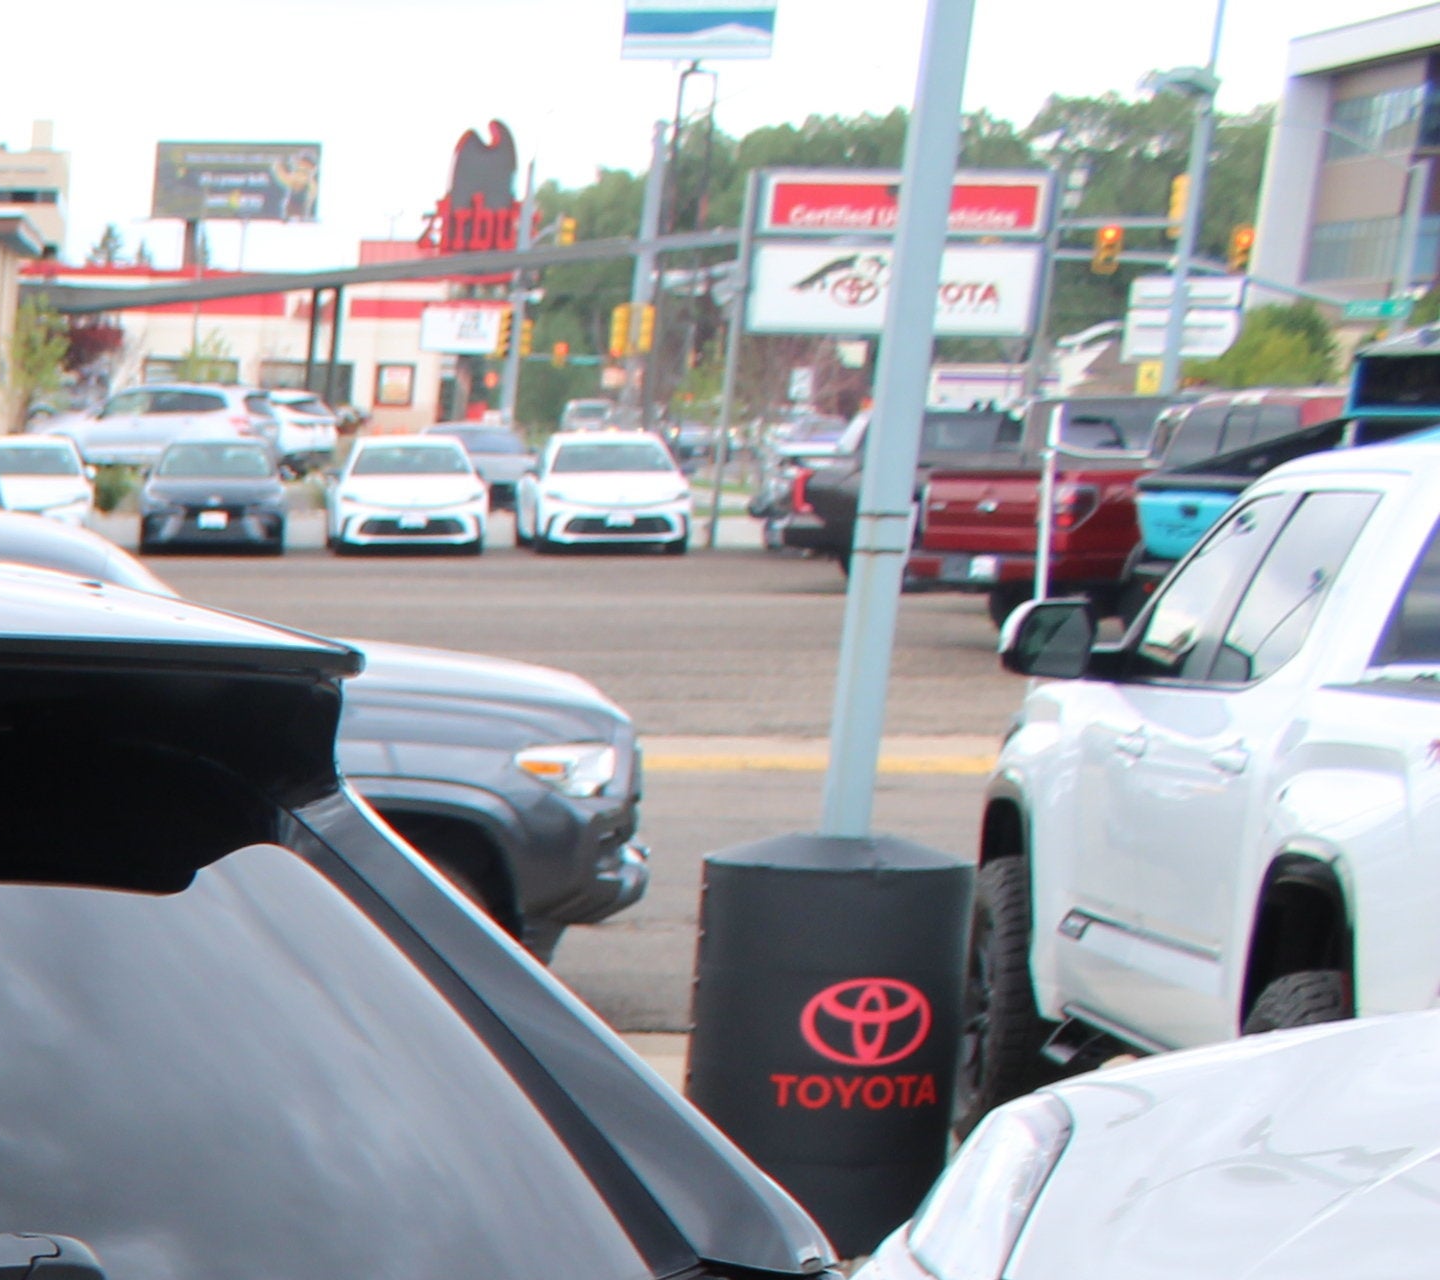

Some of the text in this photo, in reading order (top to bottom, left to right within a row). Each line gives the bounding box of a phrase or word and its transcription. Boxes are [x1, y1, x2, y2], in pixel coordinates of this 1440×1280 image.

[417, 193, 543, 253] Arby
[938, 283, 999, 304] OTA
[769, 1073, 938, 1110] TOYOTA
